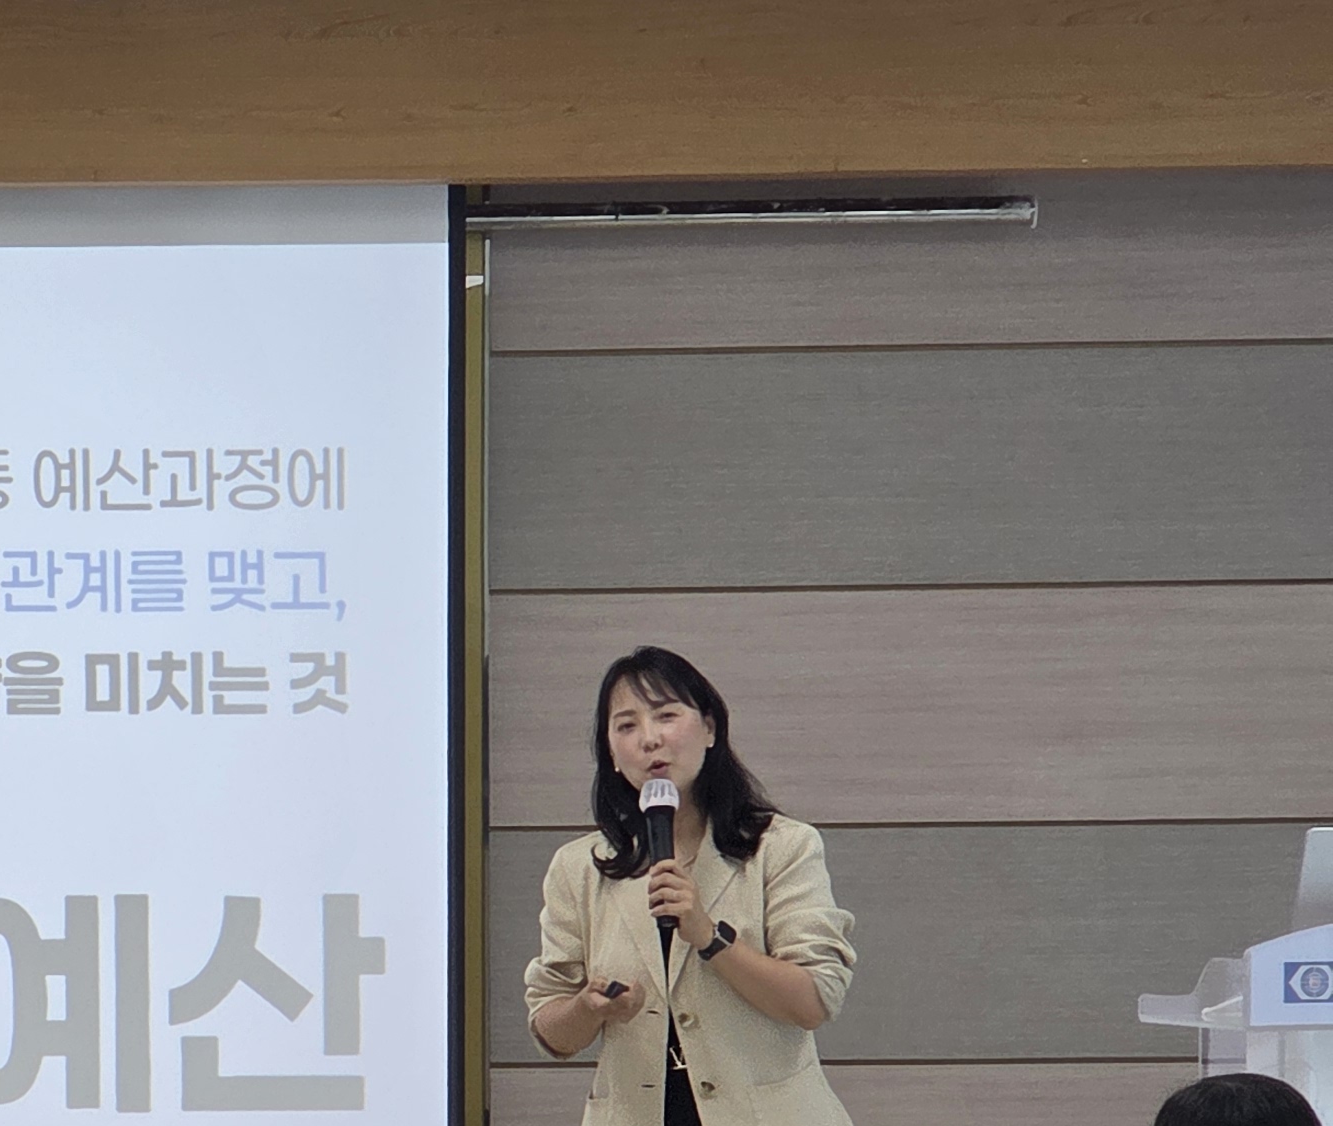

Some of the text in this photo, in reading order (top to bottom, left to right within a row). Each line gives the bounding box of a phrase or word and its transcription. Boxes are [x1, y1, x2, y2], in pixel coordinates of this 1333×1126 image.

[34, 447, 344, 511] 예산과정에
[0, 549, 187, 613] 관계를
[208, 549, 346, 621] 맺고,
[85, 651, 269, 715] 미치는
[289, 651, 348, 714] 것
